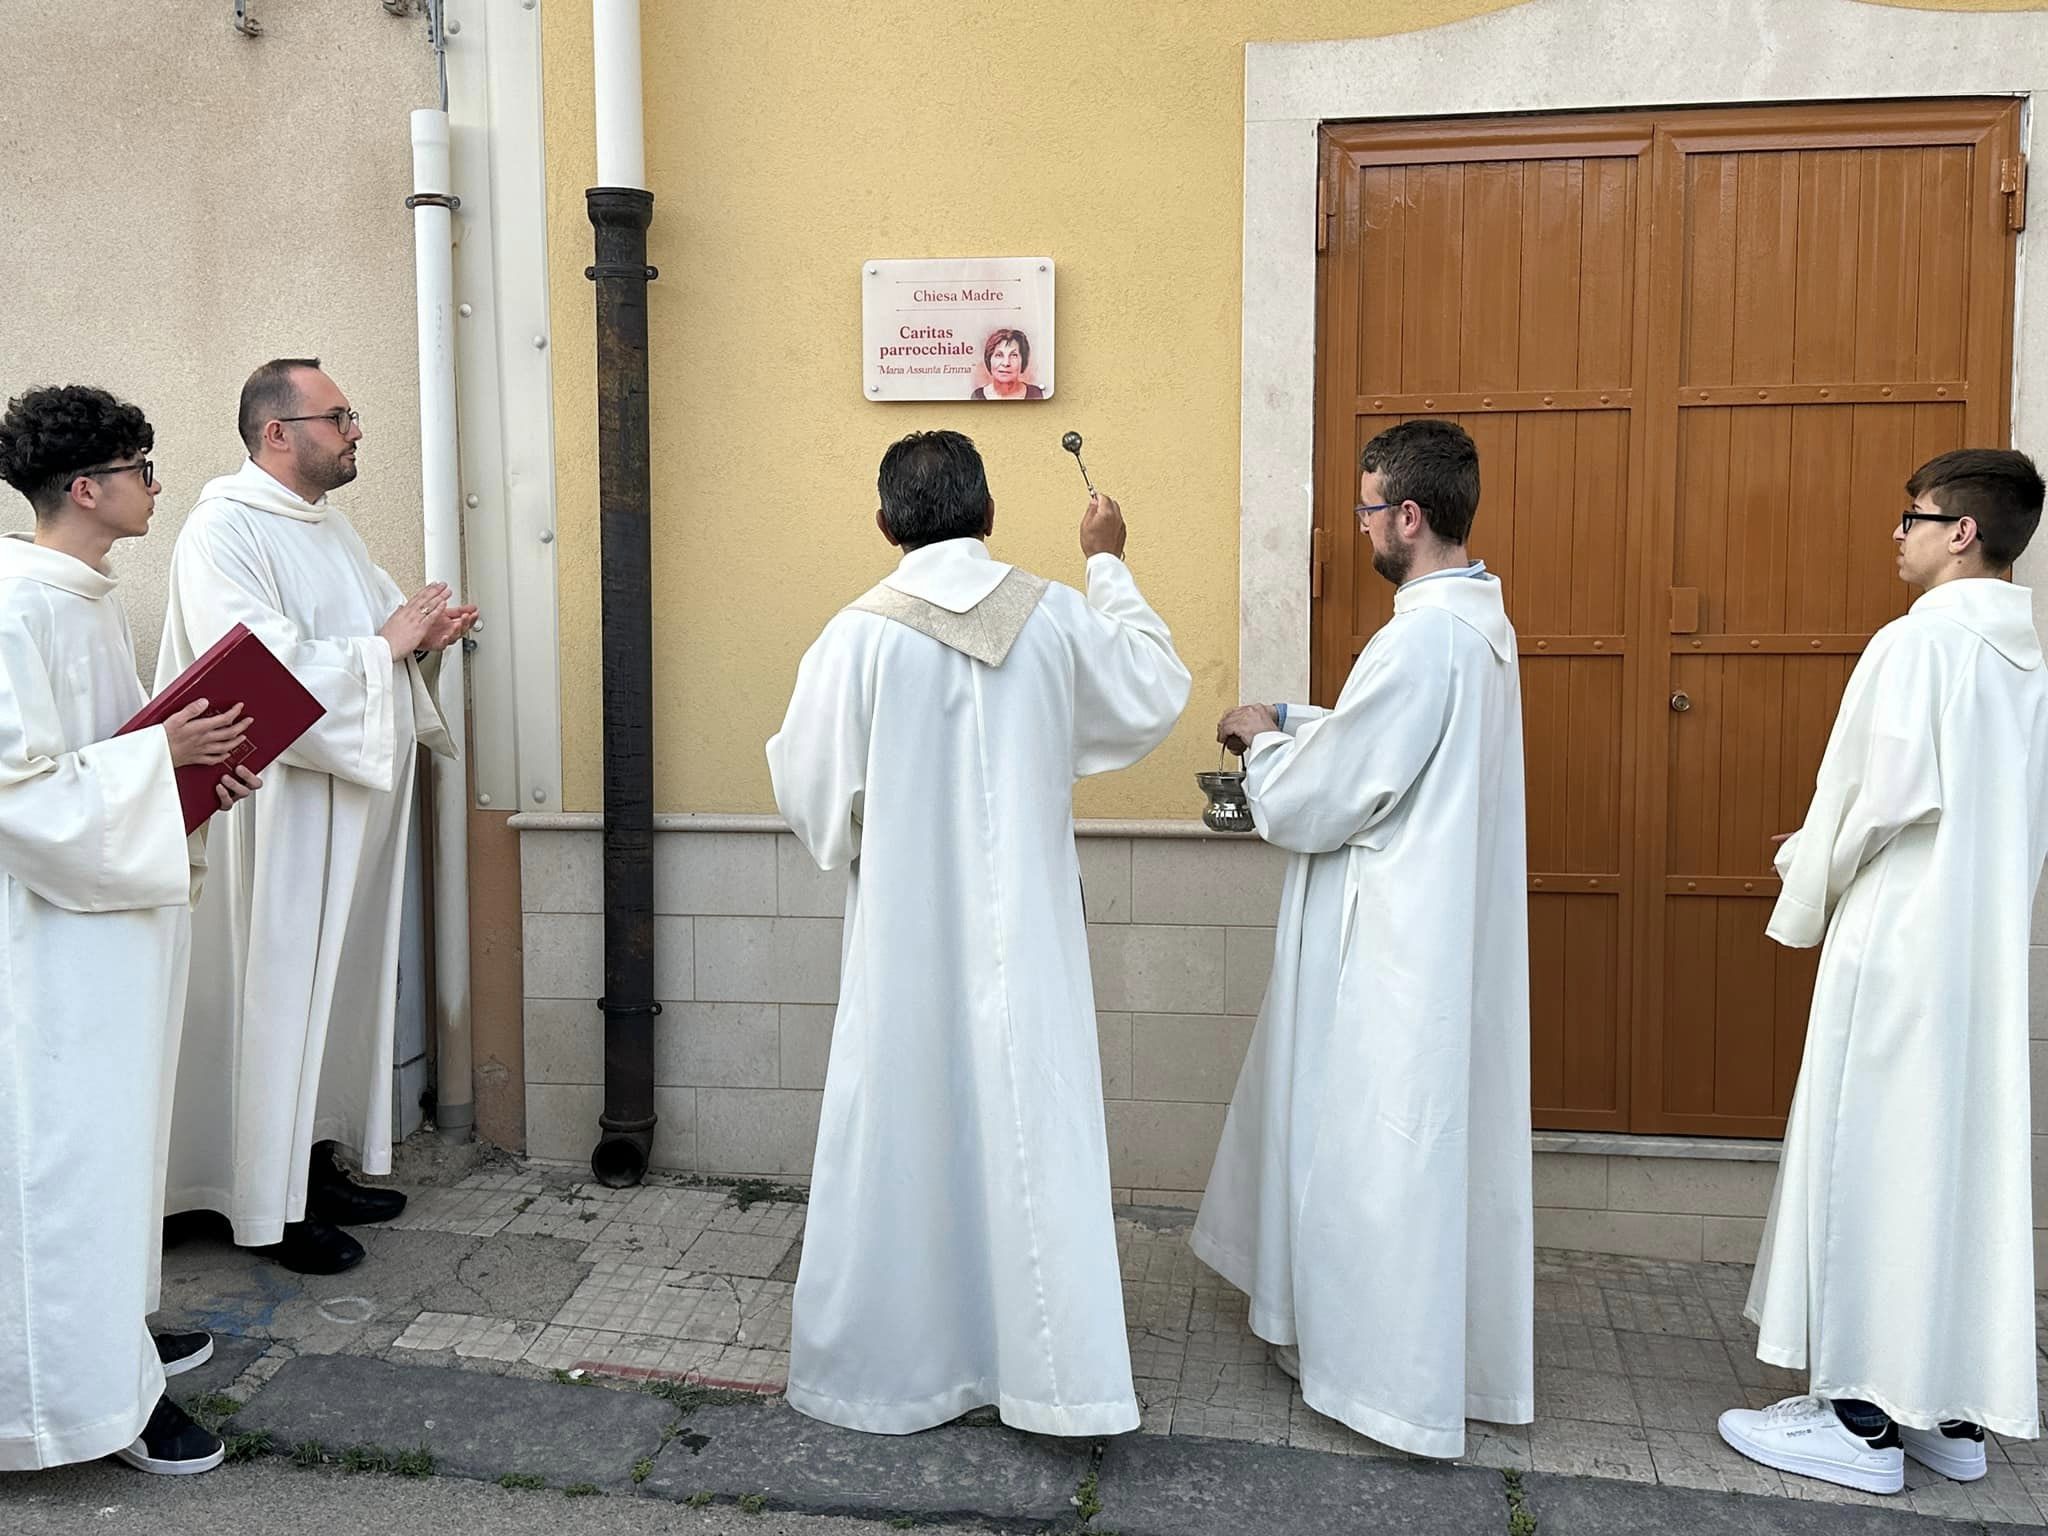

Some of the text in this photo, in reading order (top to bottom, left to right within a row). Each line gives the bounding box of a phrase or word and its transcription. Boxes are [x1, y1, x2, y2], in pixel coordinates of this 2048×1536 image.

[913, 288, 1003, 302] Chiesa Madre
[900, 325, 953, 339] Caritas
[880, 342, 973, 359] parrocchiale
